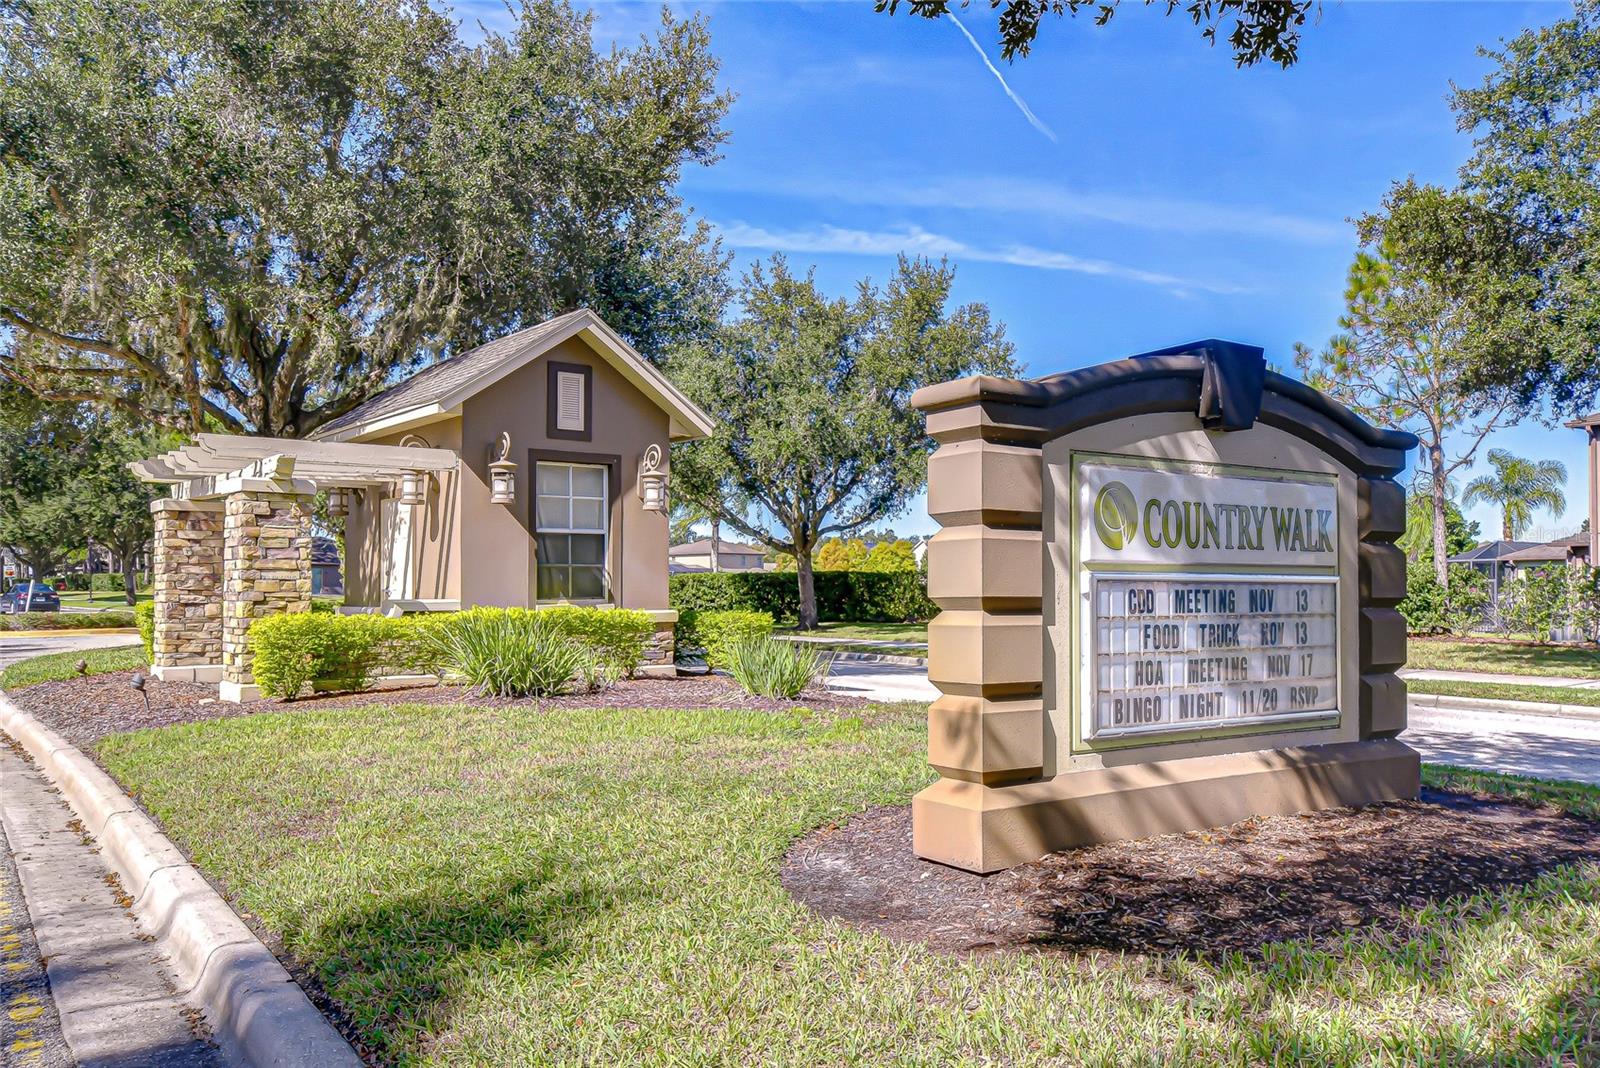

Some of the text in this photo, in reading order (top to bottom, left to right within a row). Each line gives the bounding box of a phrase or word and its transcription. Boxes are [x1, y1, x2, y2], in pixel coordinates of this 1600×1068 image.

[1128, 588, 1309, 615] CDD MEETING NOV 13
[1143, 623, 1180, 650] FOOD
[1200, 622, 1240, 648] TRUCK
[1295, 621, 1309, 645] 13
[1135, 653, 1313, 686] HOA MEETING NOV 17
[1113, 687, 1319, 724] BINGO NIGHT 11/20 RSVP
